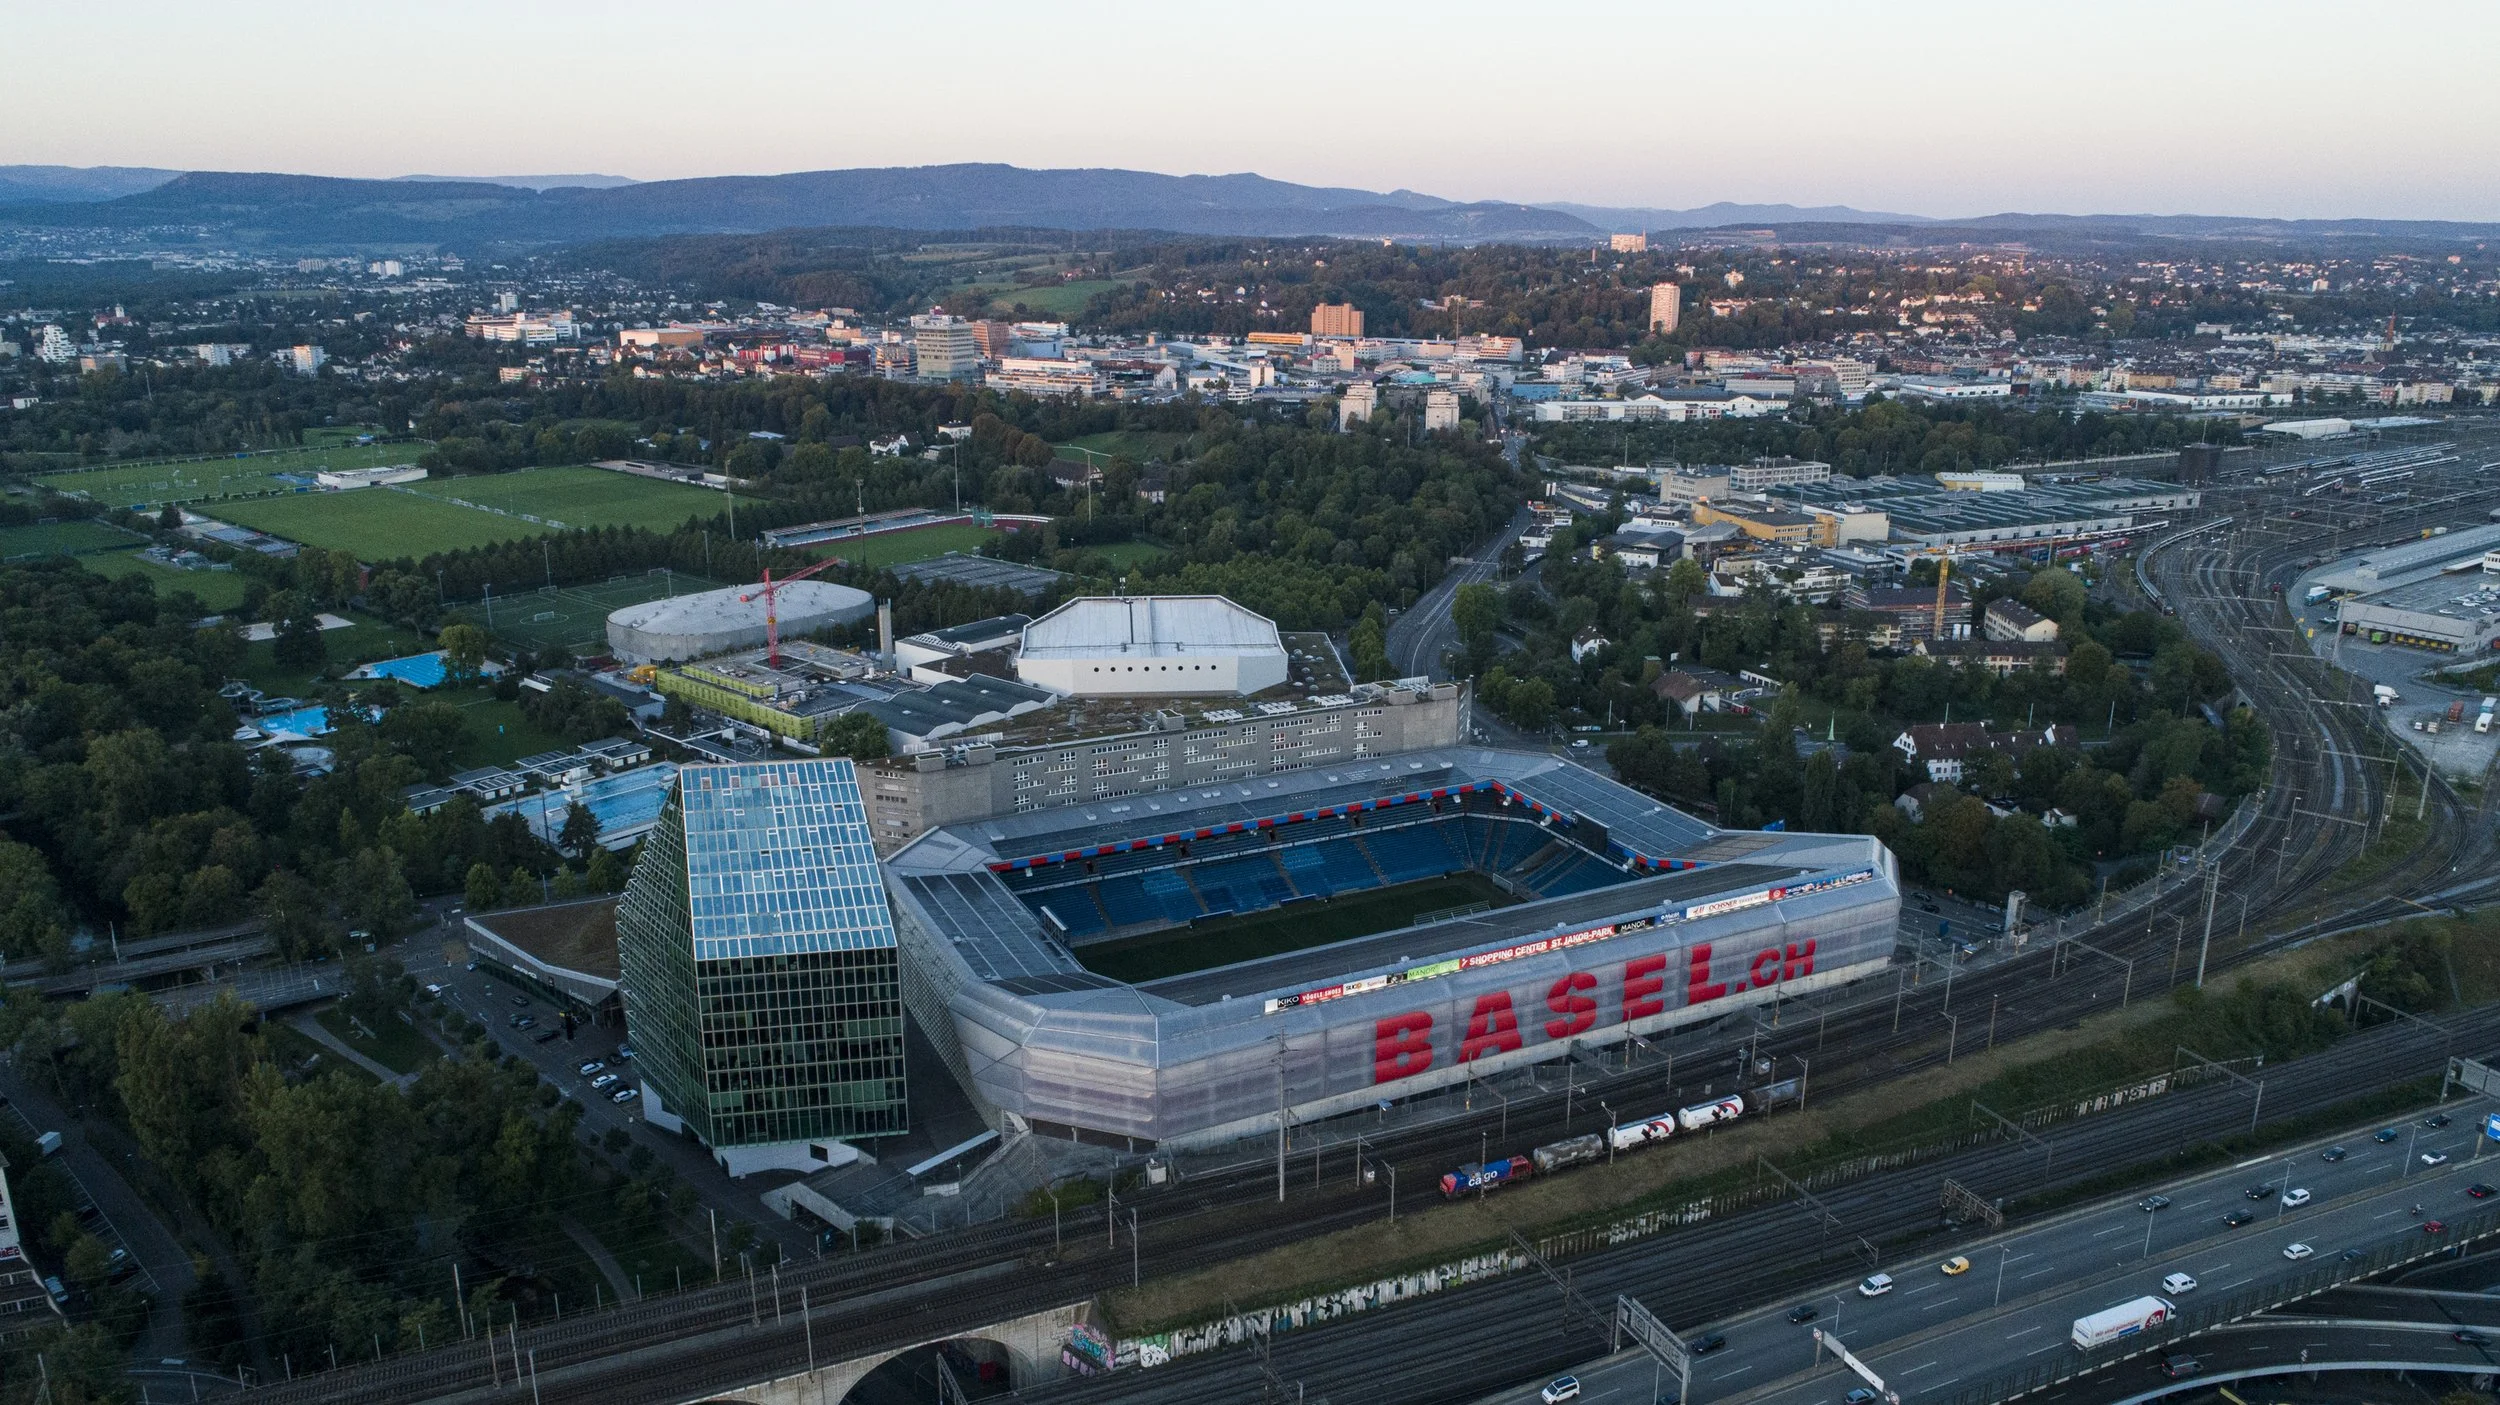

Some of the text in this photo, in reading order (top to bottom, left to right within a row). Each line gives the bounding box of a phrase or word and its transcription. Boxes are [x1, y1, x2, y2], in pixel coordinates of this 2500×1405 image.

[1708, 900, 1738, 911] OCHSNER
[1620, 920, 1646, 931] MANOR
[1469, 926, 1614, 966] SHOPPING CENTER ST. JAKOB-PARK
[1408, 967, 1436, 978] MANOR
[1324, 987, 1342, 997] SHOES
[1278, 996, 1300, 1006] KIKO
[1468, 1170, 1498, 1187] cago
